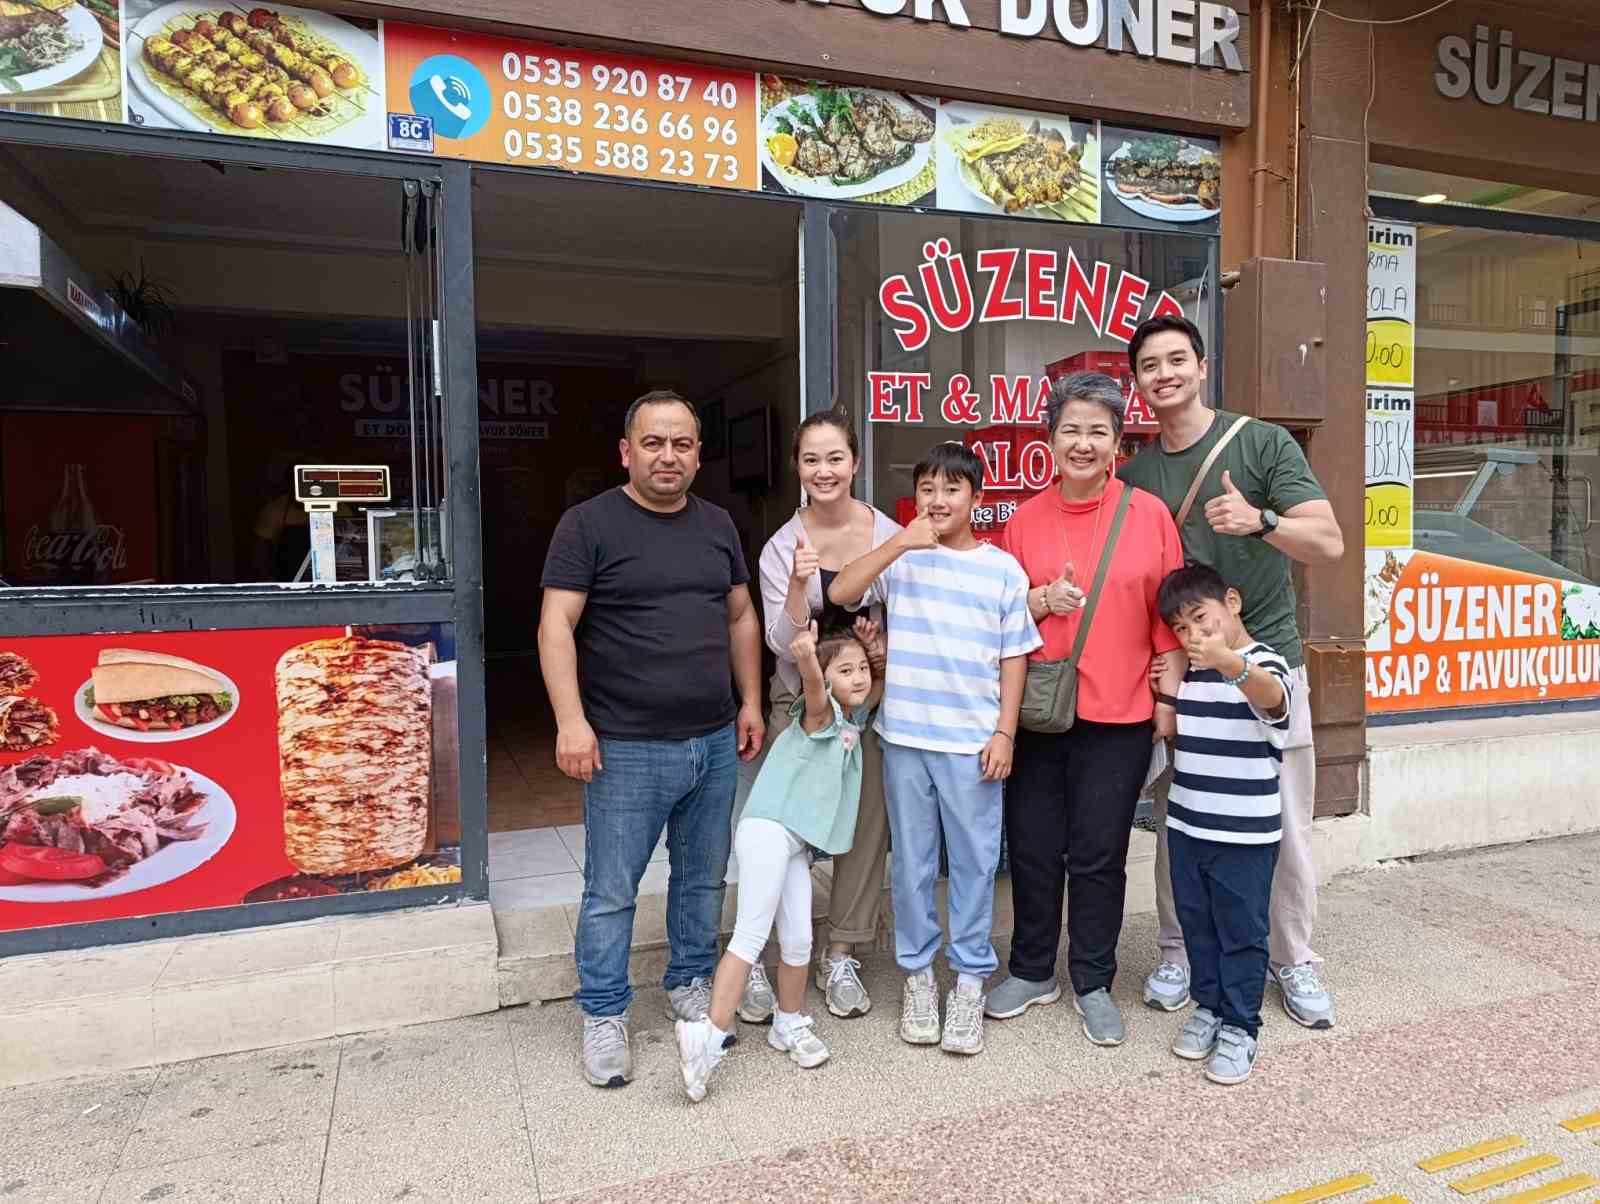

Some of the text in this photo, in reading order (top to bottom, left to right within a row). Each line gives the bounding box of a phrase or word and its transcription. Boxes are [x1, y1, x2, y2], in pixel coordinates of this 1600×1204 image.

[502, 52, 737, 109] 0535 920 87 40
[400, 121, 422, 138] 8C
[503, 91, 738, 145] 0538 236 66 96
[504, 129, 738, 181] 0535 588 23 73
[338, 364, 558, 415] SÜNER
[868, 371, 931, 422] ET
[941, 374, 980, 423] &
[1394, 571, 1558, 645] SÜZENER
[1436, 656, 1451, 693] &
